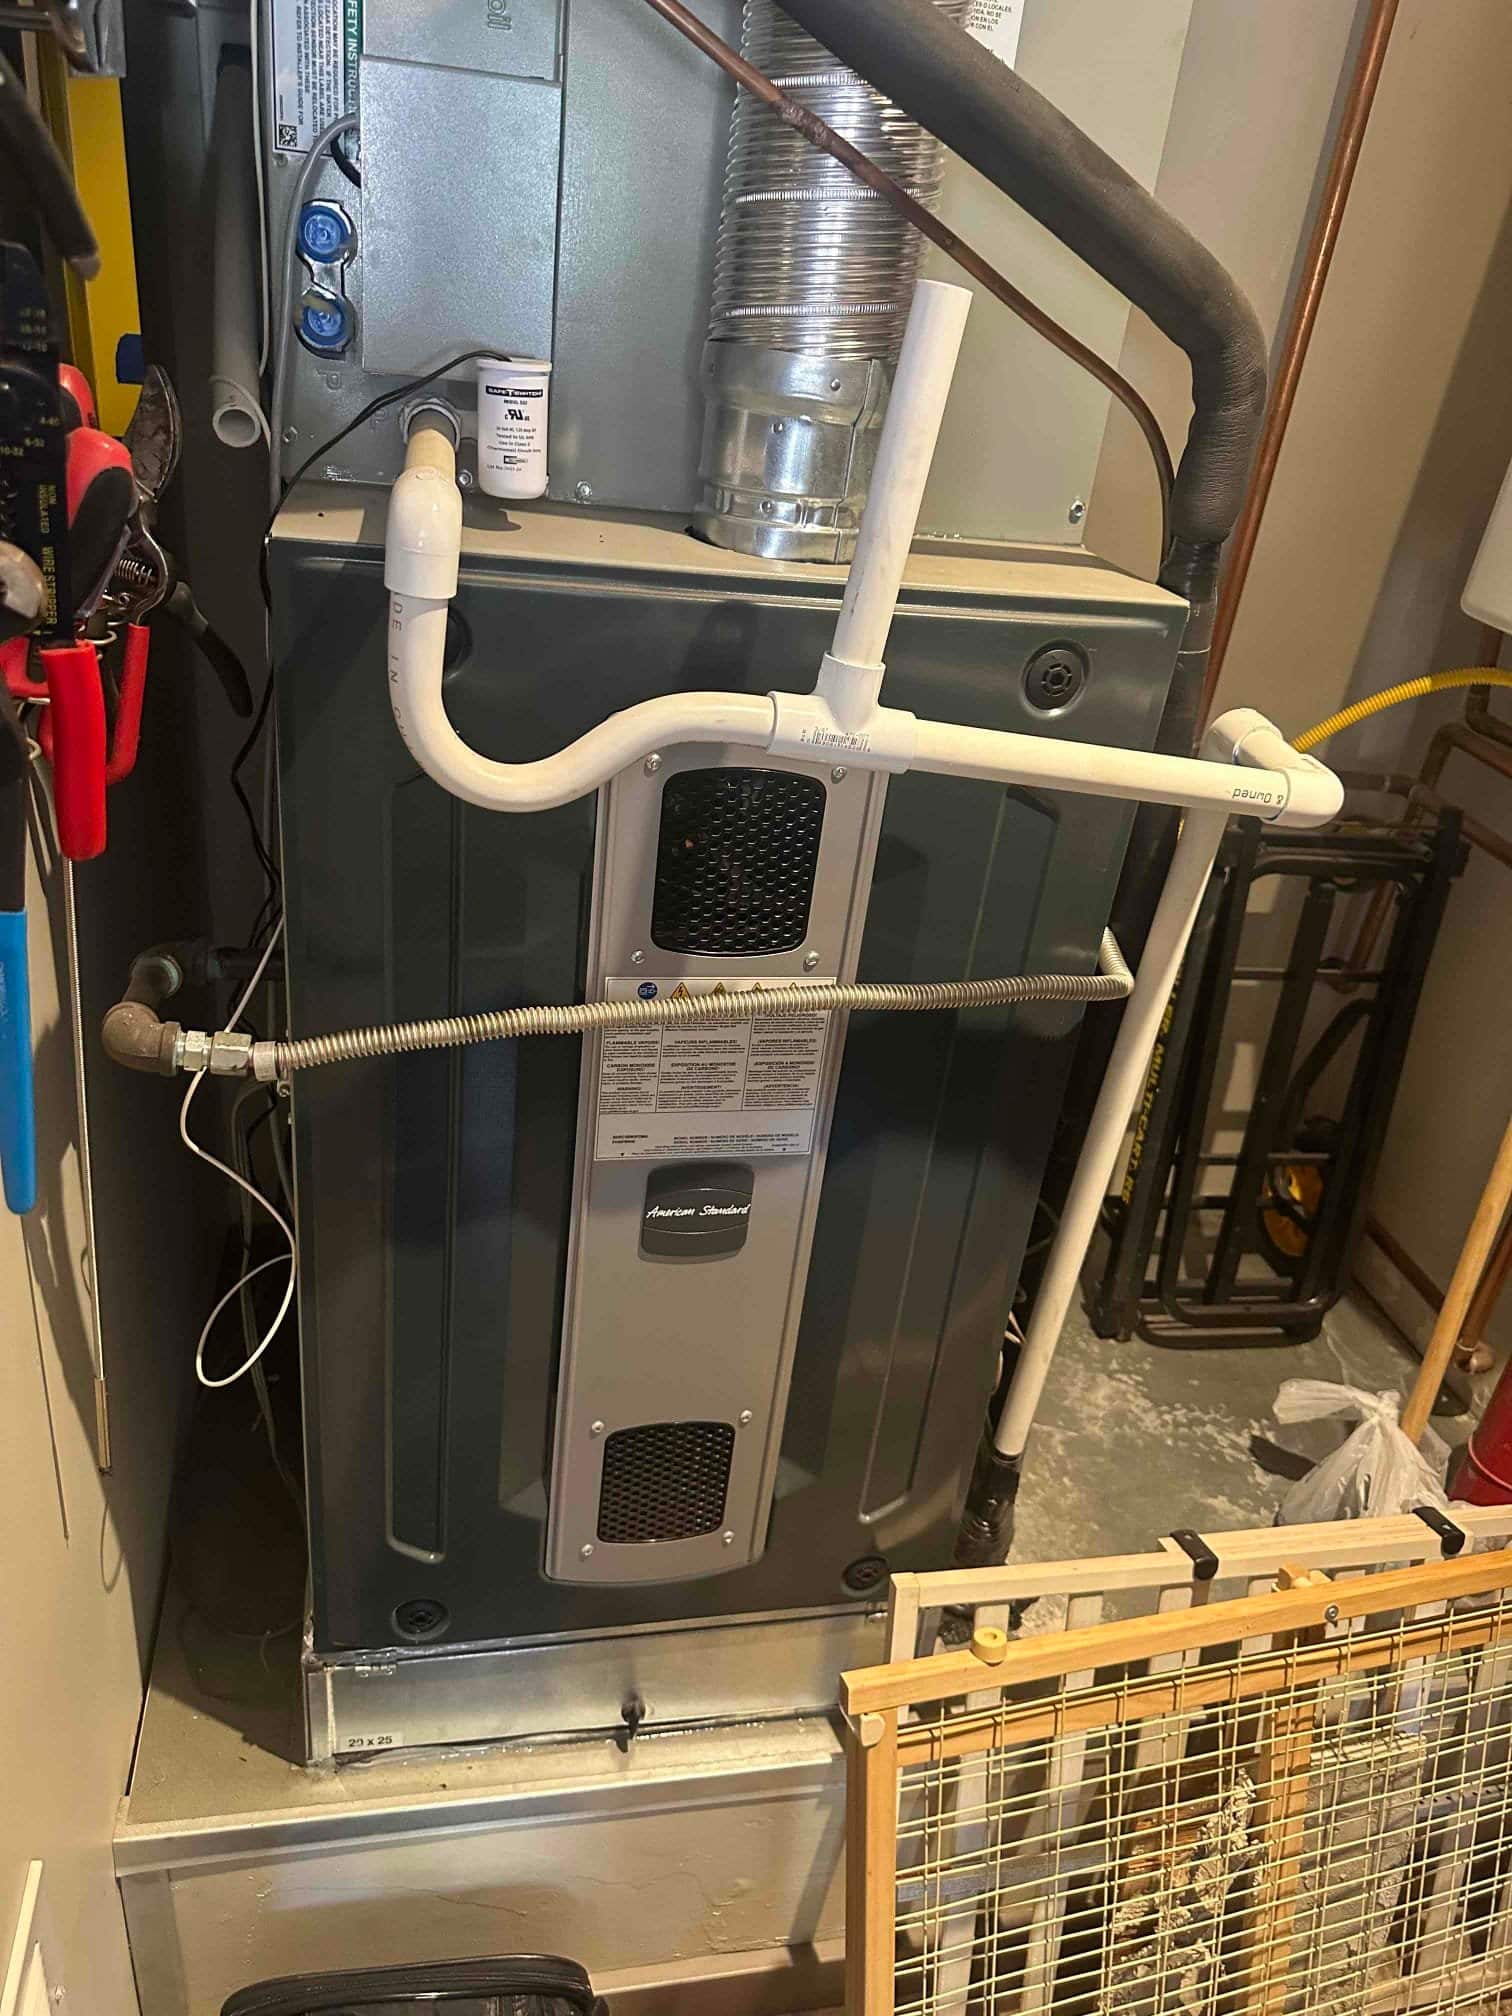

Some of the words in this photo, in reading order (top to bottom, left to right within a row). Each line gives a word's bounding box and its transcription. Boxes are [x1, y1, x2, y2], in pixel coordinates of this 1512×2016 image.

[346, 0, 358, 34] FETY
[346, 39, 358, 115] INSTRUCTI
[42, 546, 56, 573] WIRE
[46, 575, 58, 625] STRIPPER
[392, 602, 403, 632] DE
[646, 1206, 696, 1219] American
[699, 1204, 752, 1216] Standard
[377, 1736, 393, 1745] 25
